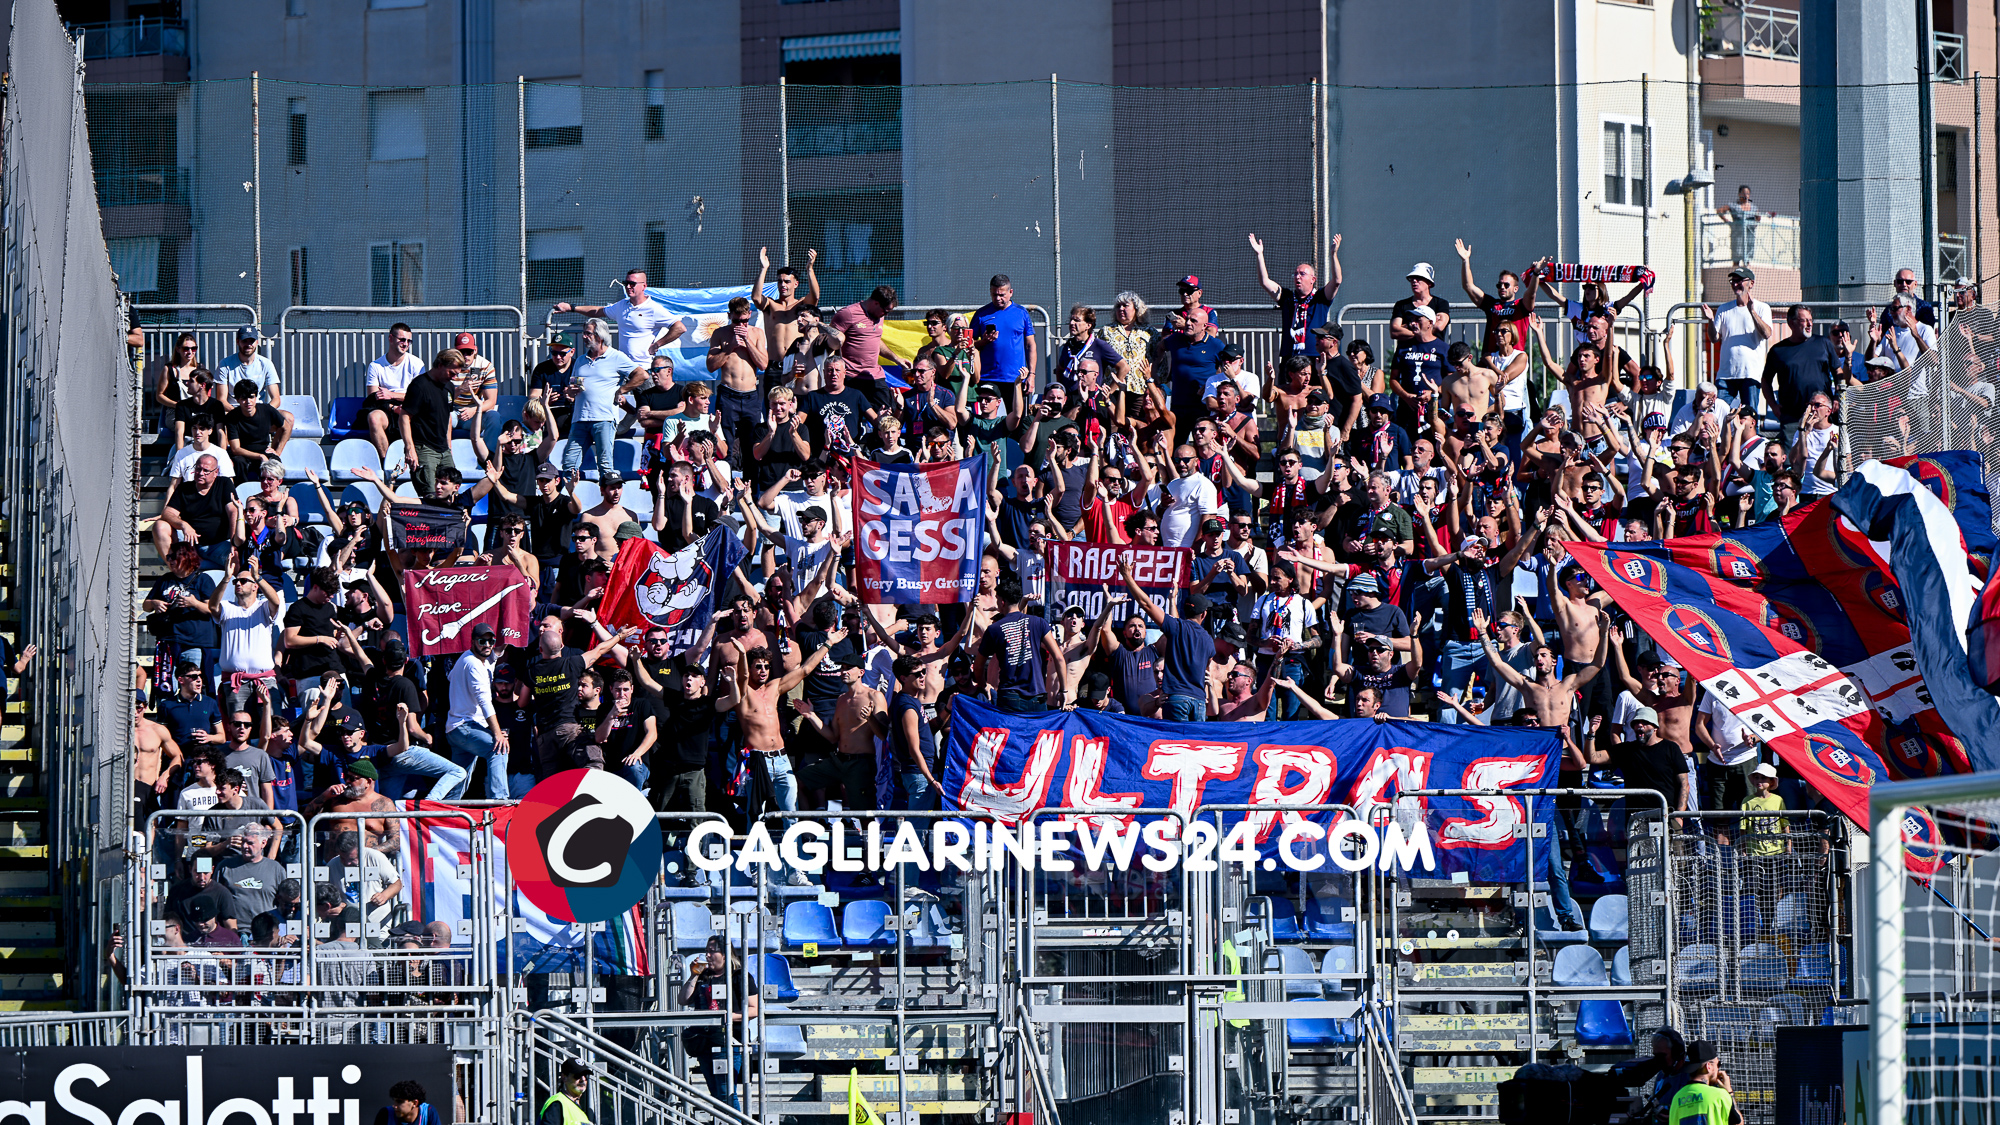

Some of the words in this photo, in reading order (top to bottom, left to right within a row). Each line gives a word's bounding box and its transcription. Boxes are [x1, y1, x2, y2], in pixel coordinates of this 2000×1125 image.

[1555, 262, 1618, 282] BOLOGNA
[860, 517, 977, 563] GESSI
[414, 568, 491, 593] Magari
[863, 577, 894, 593] Very
[896, 577, 933, 593] Busy
[935, 576, 976, 591] Group
[958, 727, 1549, 850] ULTRAS
